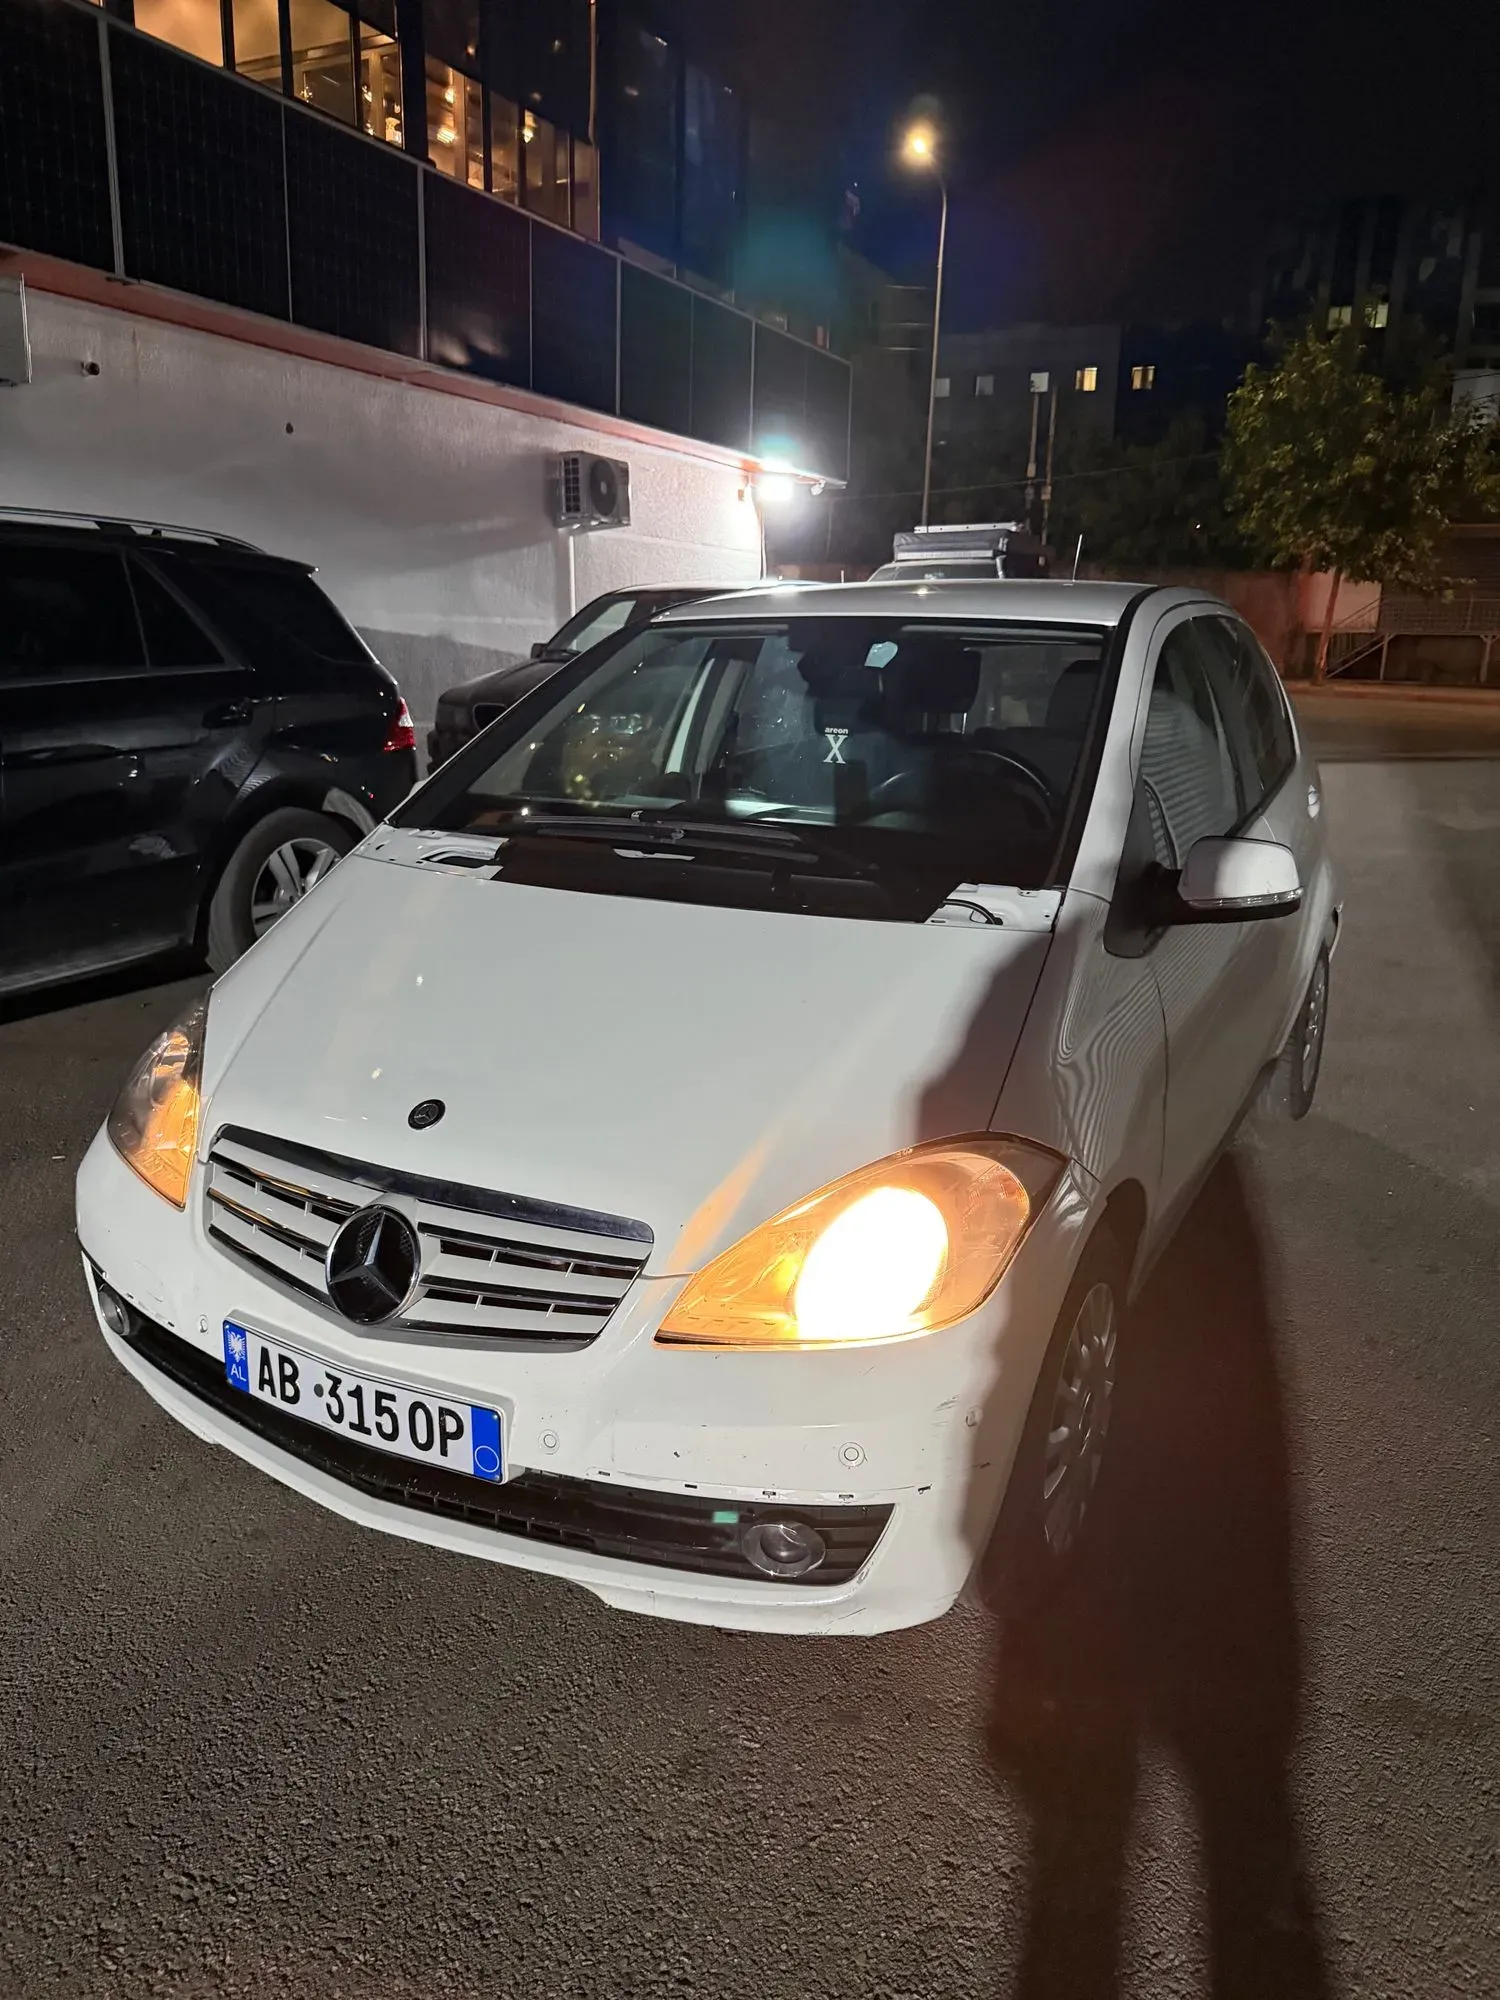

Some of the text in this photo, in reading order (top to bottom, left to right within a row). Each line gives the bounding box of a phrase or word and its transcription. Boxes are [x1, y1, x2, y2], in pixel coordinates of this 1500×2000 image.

[823, 734, 848, 764] X
[230, 1363, 246, 1382] AL
[258, 1346, 300, 1405] AB
